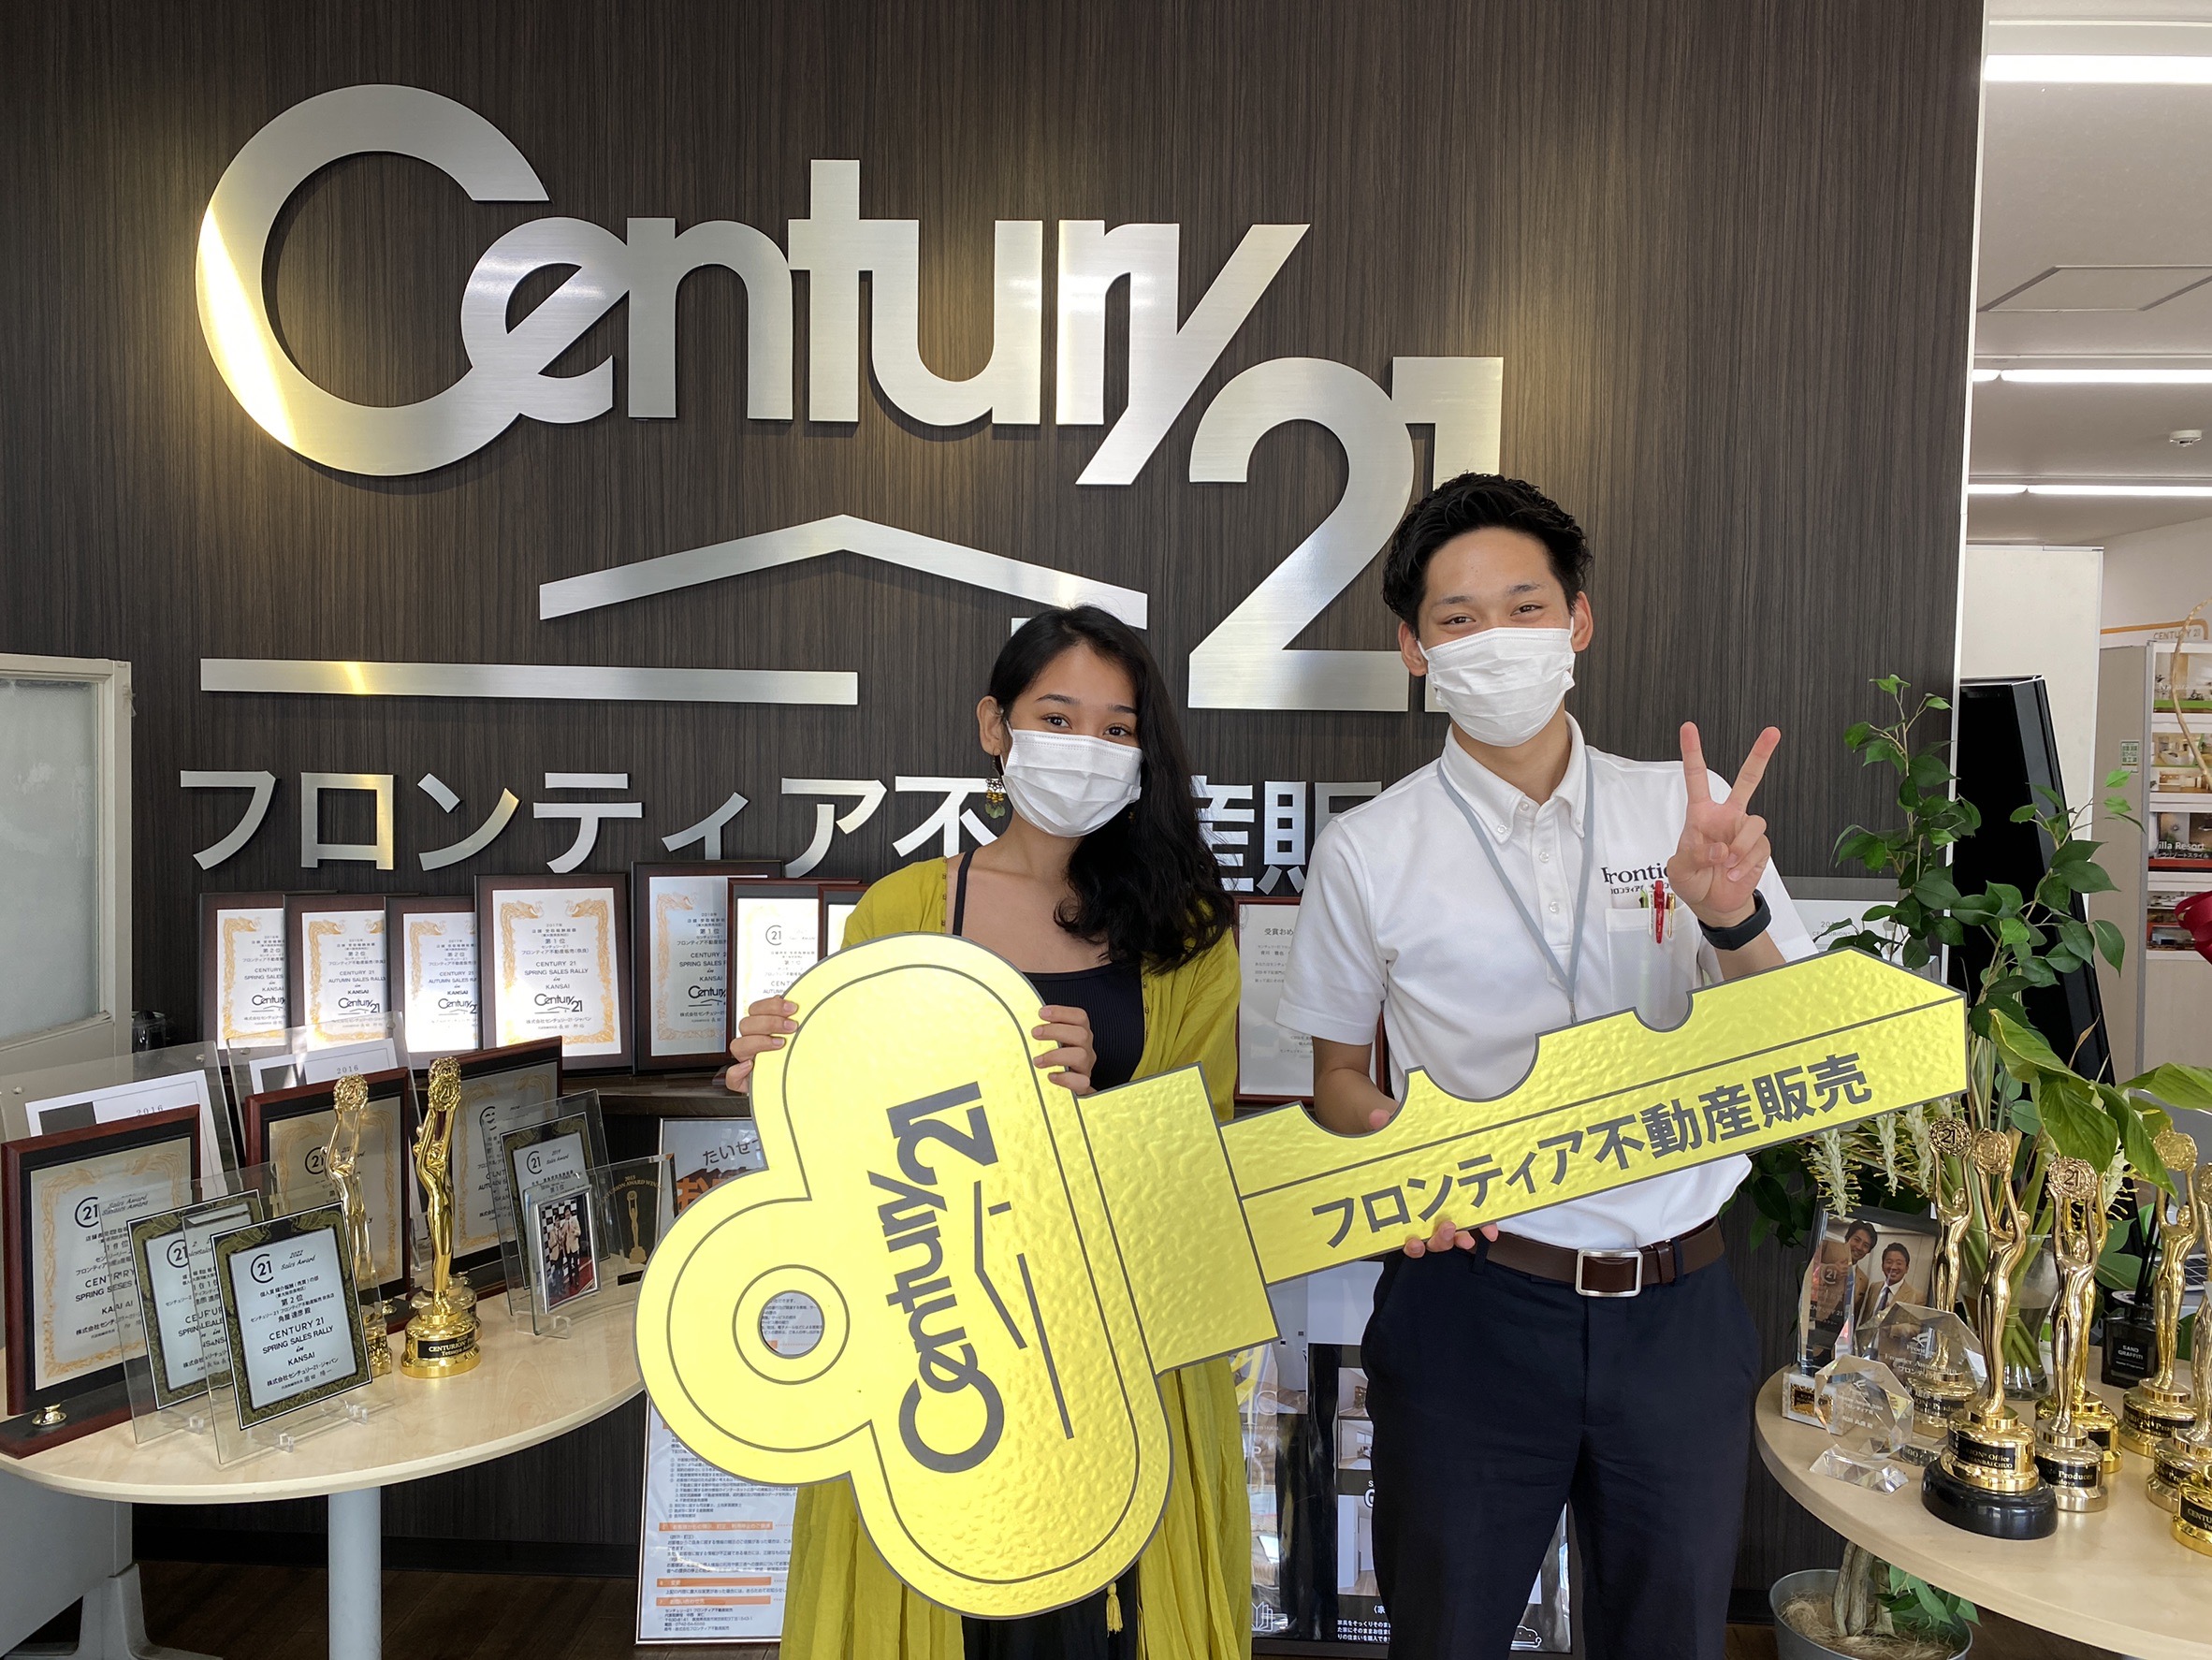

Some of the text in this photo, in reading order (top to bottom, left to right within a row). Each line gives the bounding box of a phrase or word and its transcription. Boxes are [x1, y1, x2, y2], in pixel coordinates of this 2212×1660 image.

[195, 82, 1309, 486] Century
[2154, 630, 2191, 640] CENTUY
[2175, 841, 2205, 851] Resort
[338, 997, 380, 1013] Century 21
[438, 997, 472, 1009] Century
[534, 993, 583, 1012] Century 21
[336, 1065, 359, 1075] 2016
[1942, 1129, 1956, 1144] 21
[1312, 1052, 1872, 1249] フロンティア不動産販売
[2063, 1170, 2081, 1187] 21
[289, 1249, 304, 1260] 2022
[281, 1255, 316, 1272] Sales Award
[866, 1081, 1005, 1474] Century 21
[269, 1317, 325, 1341] CENTURY 21
[262, 1324, 334, 1355] SPRING SALES RALLY
[428, 1340, 466, 1353] CENTURION
[2117, 1349, 2144, 1361] GRAFFITI
[2122, 1345, 2139, 1353] SAND
[287, 1351, 315, 1366] KANSAI
[1988, 1451, 2011, 1462] Office
[2059, 1470, 2094, 1480] Producer
[2187, 1507, 2212, 1523] CENTU
